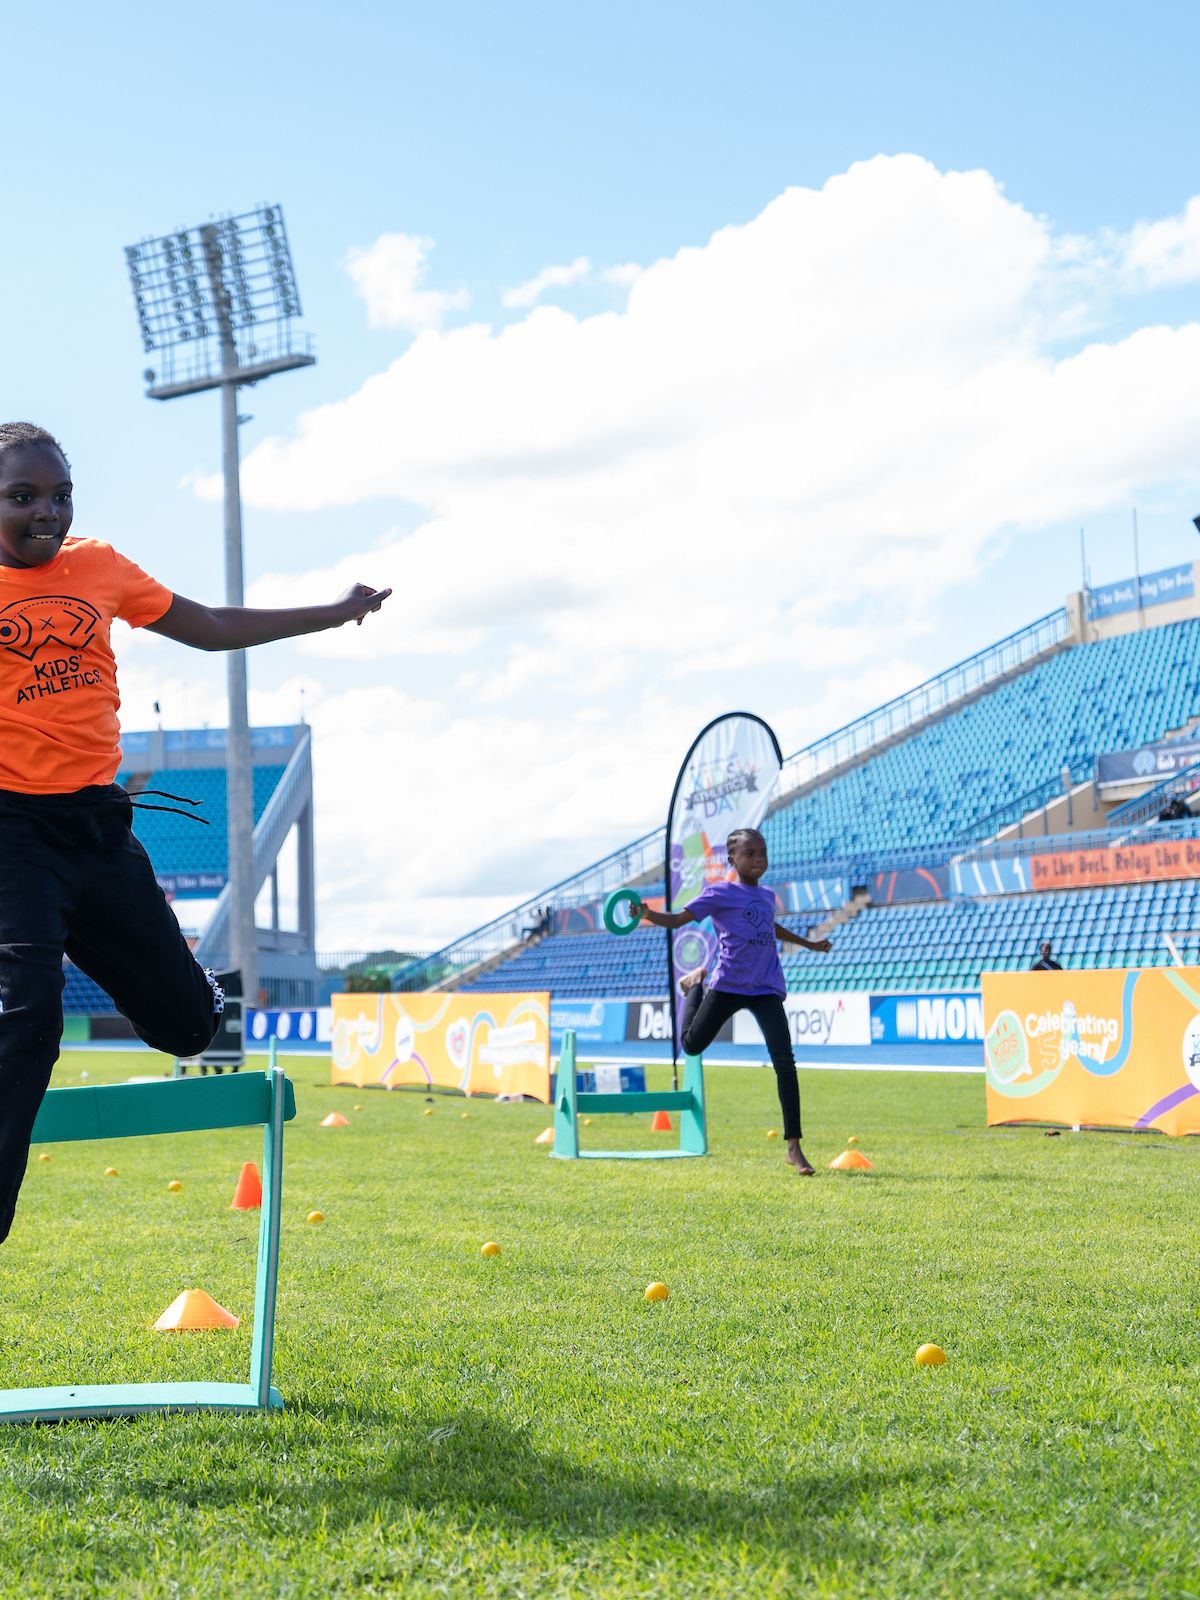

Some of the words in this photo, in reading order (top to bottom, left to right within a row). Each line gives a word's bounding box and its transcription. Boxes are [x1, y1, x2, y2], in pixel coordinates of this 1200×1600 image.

[16, 669, 100, 705] ATHLETICS
[704, 792, 742, 818] DAY
[1025, 1010, 1118, 1042] Celebrating
